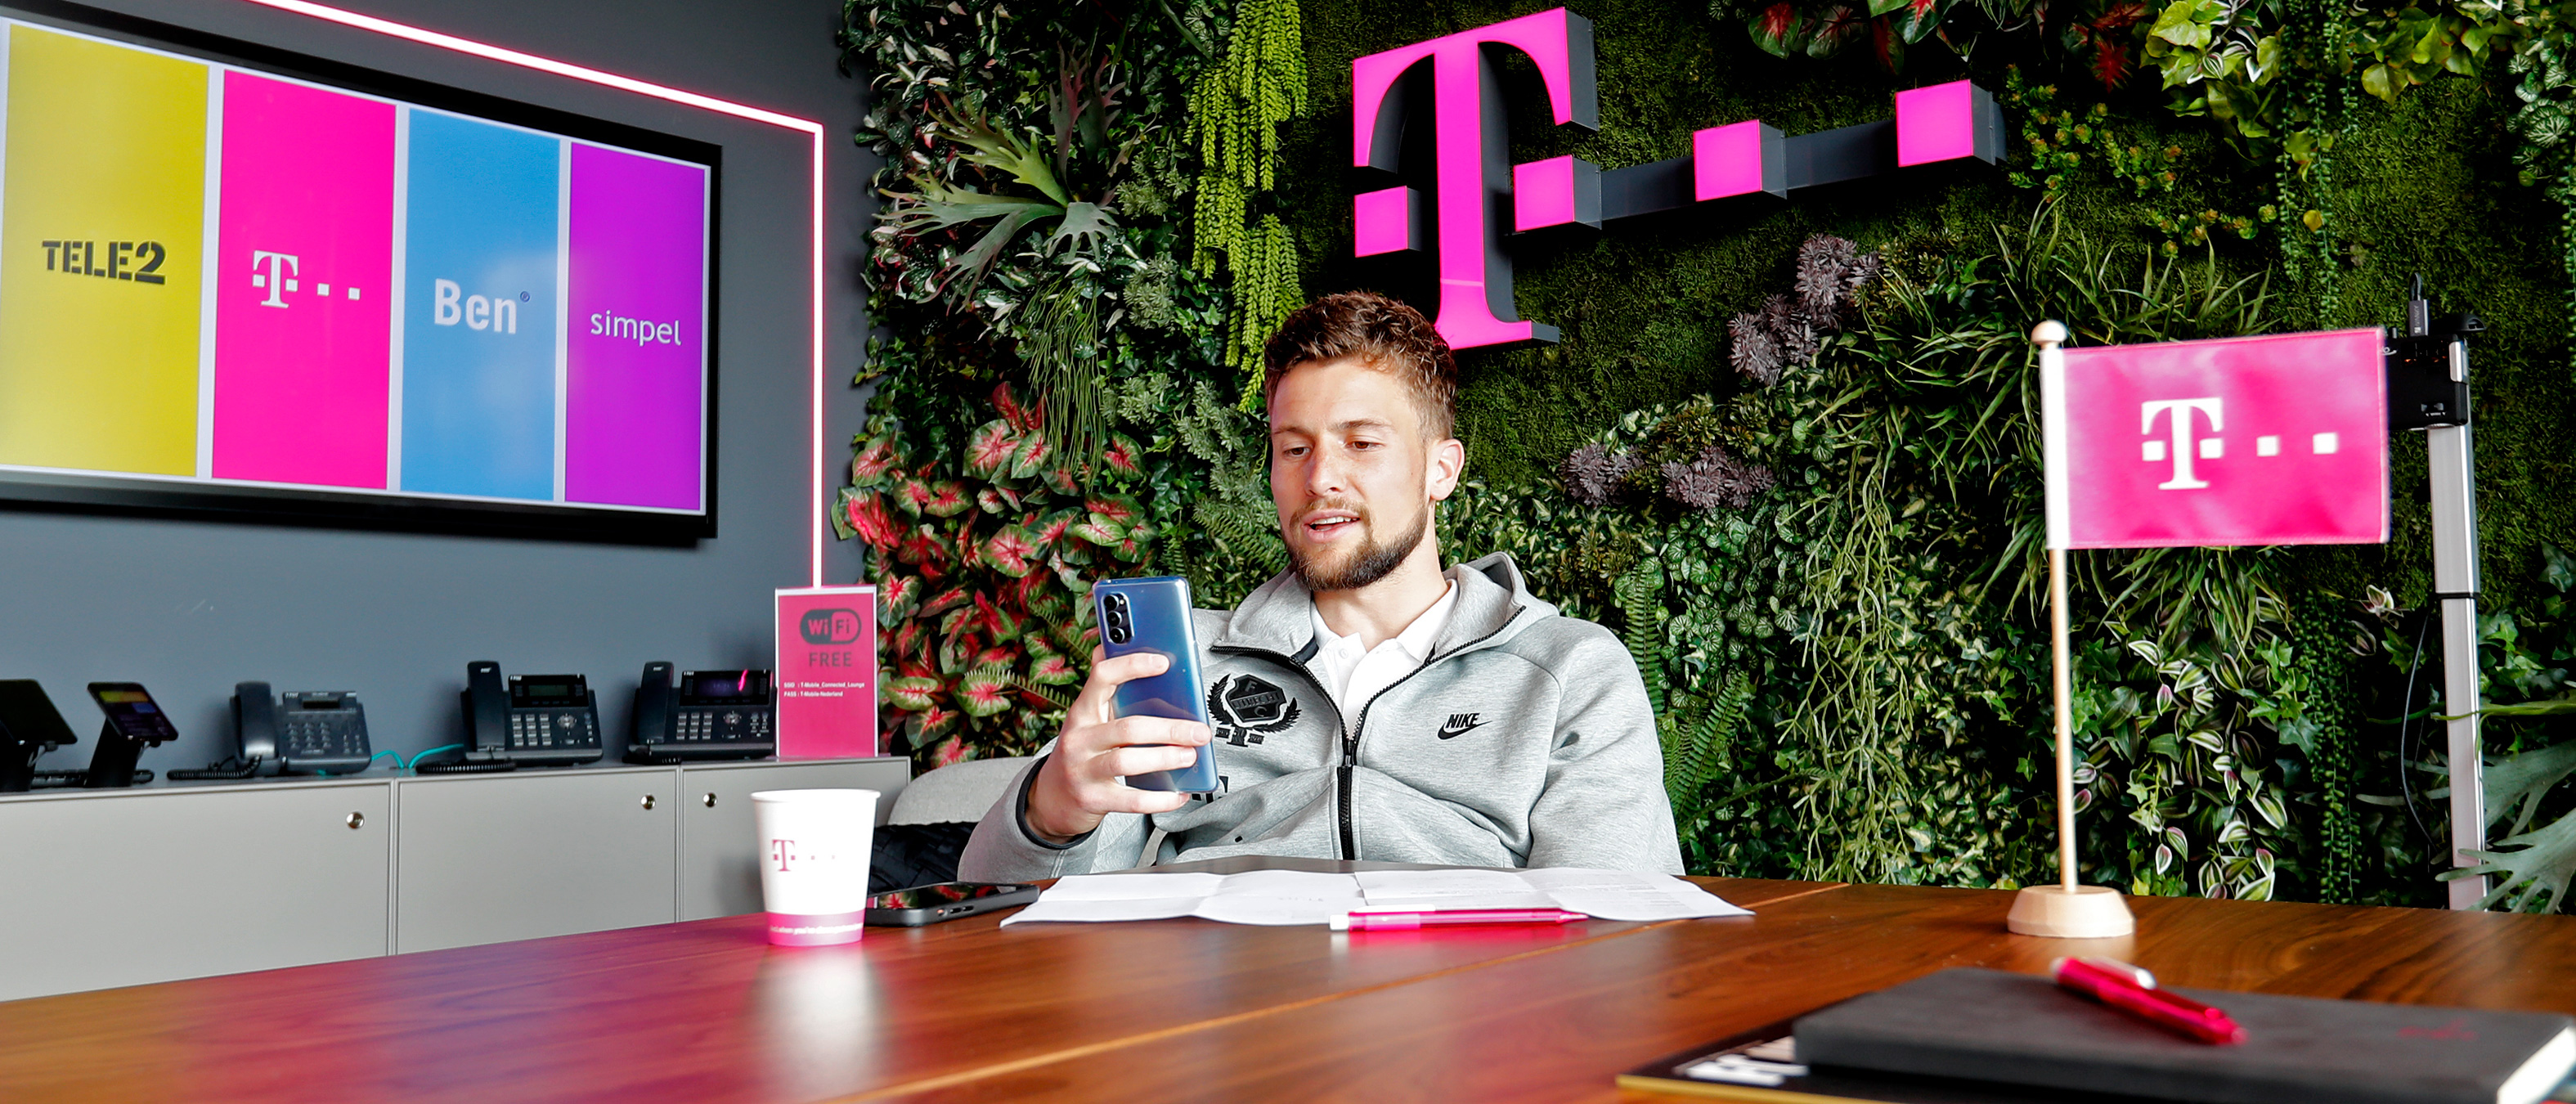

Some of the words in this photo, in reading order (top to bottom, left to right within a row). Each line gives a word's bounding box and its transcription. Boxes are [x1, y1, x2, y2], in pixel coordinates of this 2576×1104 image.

[43, 240, 166, 285] TELE2
[590, 310, 681, 346] simpel
[809, 652, 852, 666] FREE
[1446, 713, 1480, 728] NIKE
